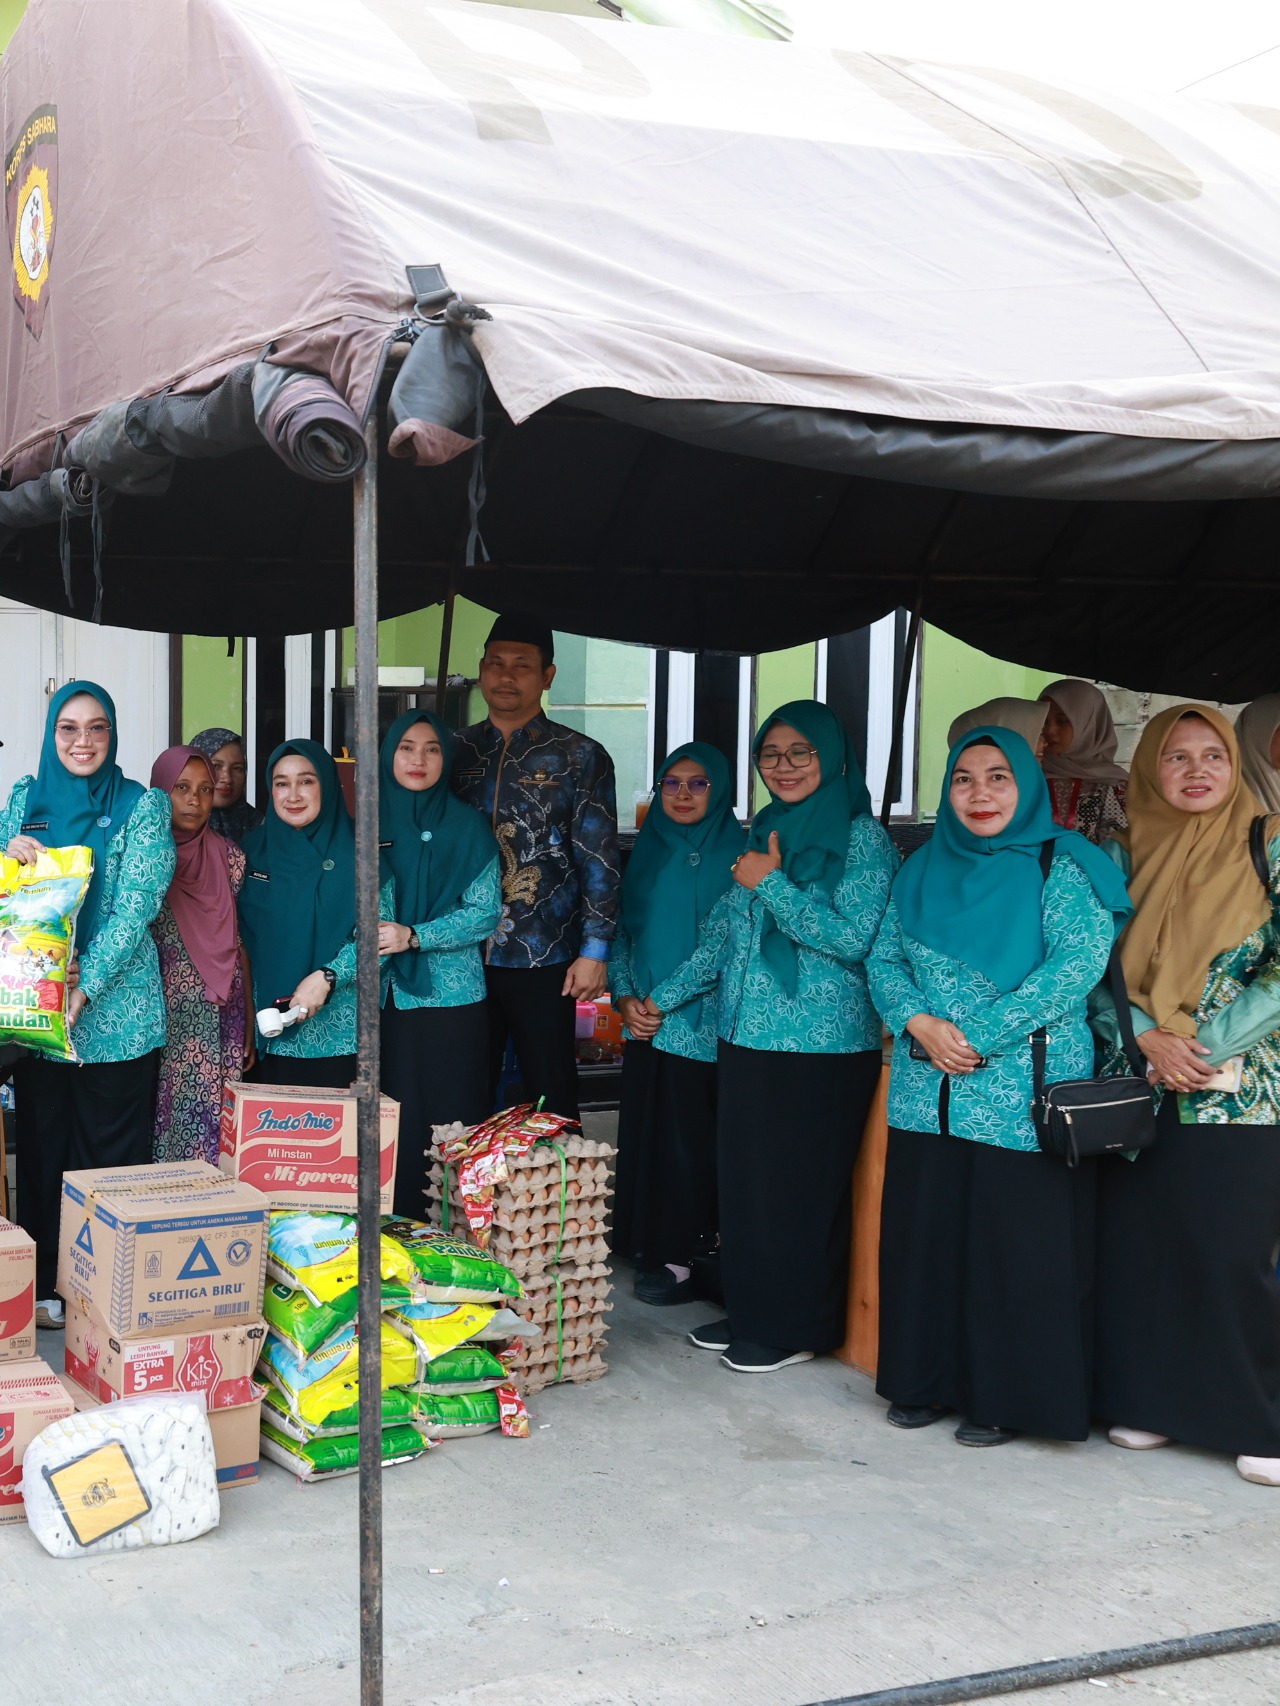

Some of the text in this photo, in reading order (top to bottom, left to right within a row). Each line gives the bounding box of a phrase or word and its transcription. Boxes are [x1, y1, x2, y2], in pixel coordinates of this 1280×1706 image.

[6, 115, 57, 186] KORPS SABHARA
[246, 1108, 334, 1137] Indomie
[267, 1148, 312, 1160] Mi Instan
[264, 1165, 298, 1182] Mi
[69, 1246, 97, 1276] SEGITIGA
[74, 1263, 90, 1281] BIRU
[148, 1283, 242, 1302] SEGITIGA BIRU
[138, 1344, 161, 1352] UNTUNG
[147, 1350, 168, 1358] BANYAK
[133, 1359, 164, 1371] EXTRA
[133, 1370, 164, 1391] 5 pcs
[191, 1379, 208, 1387] mint
